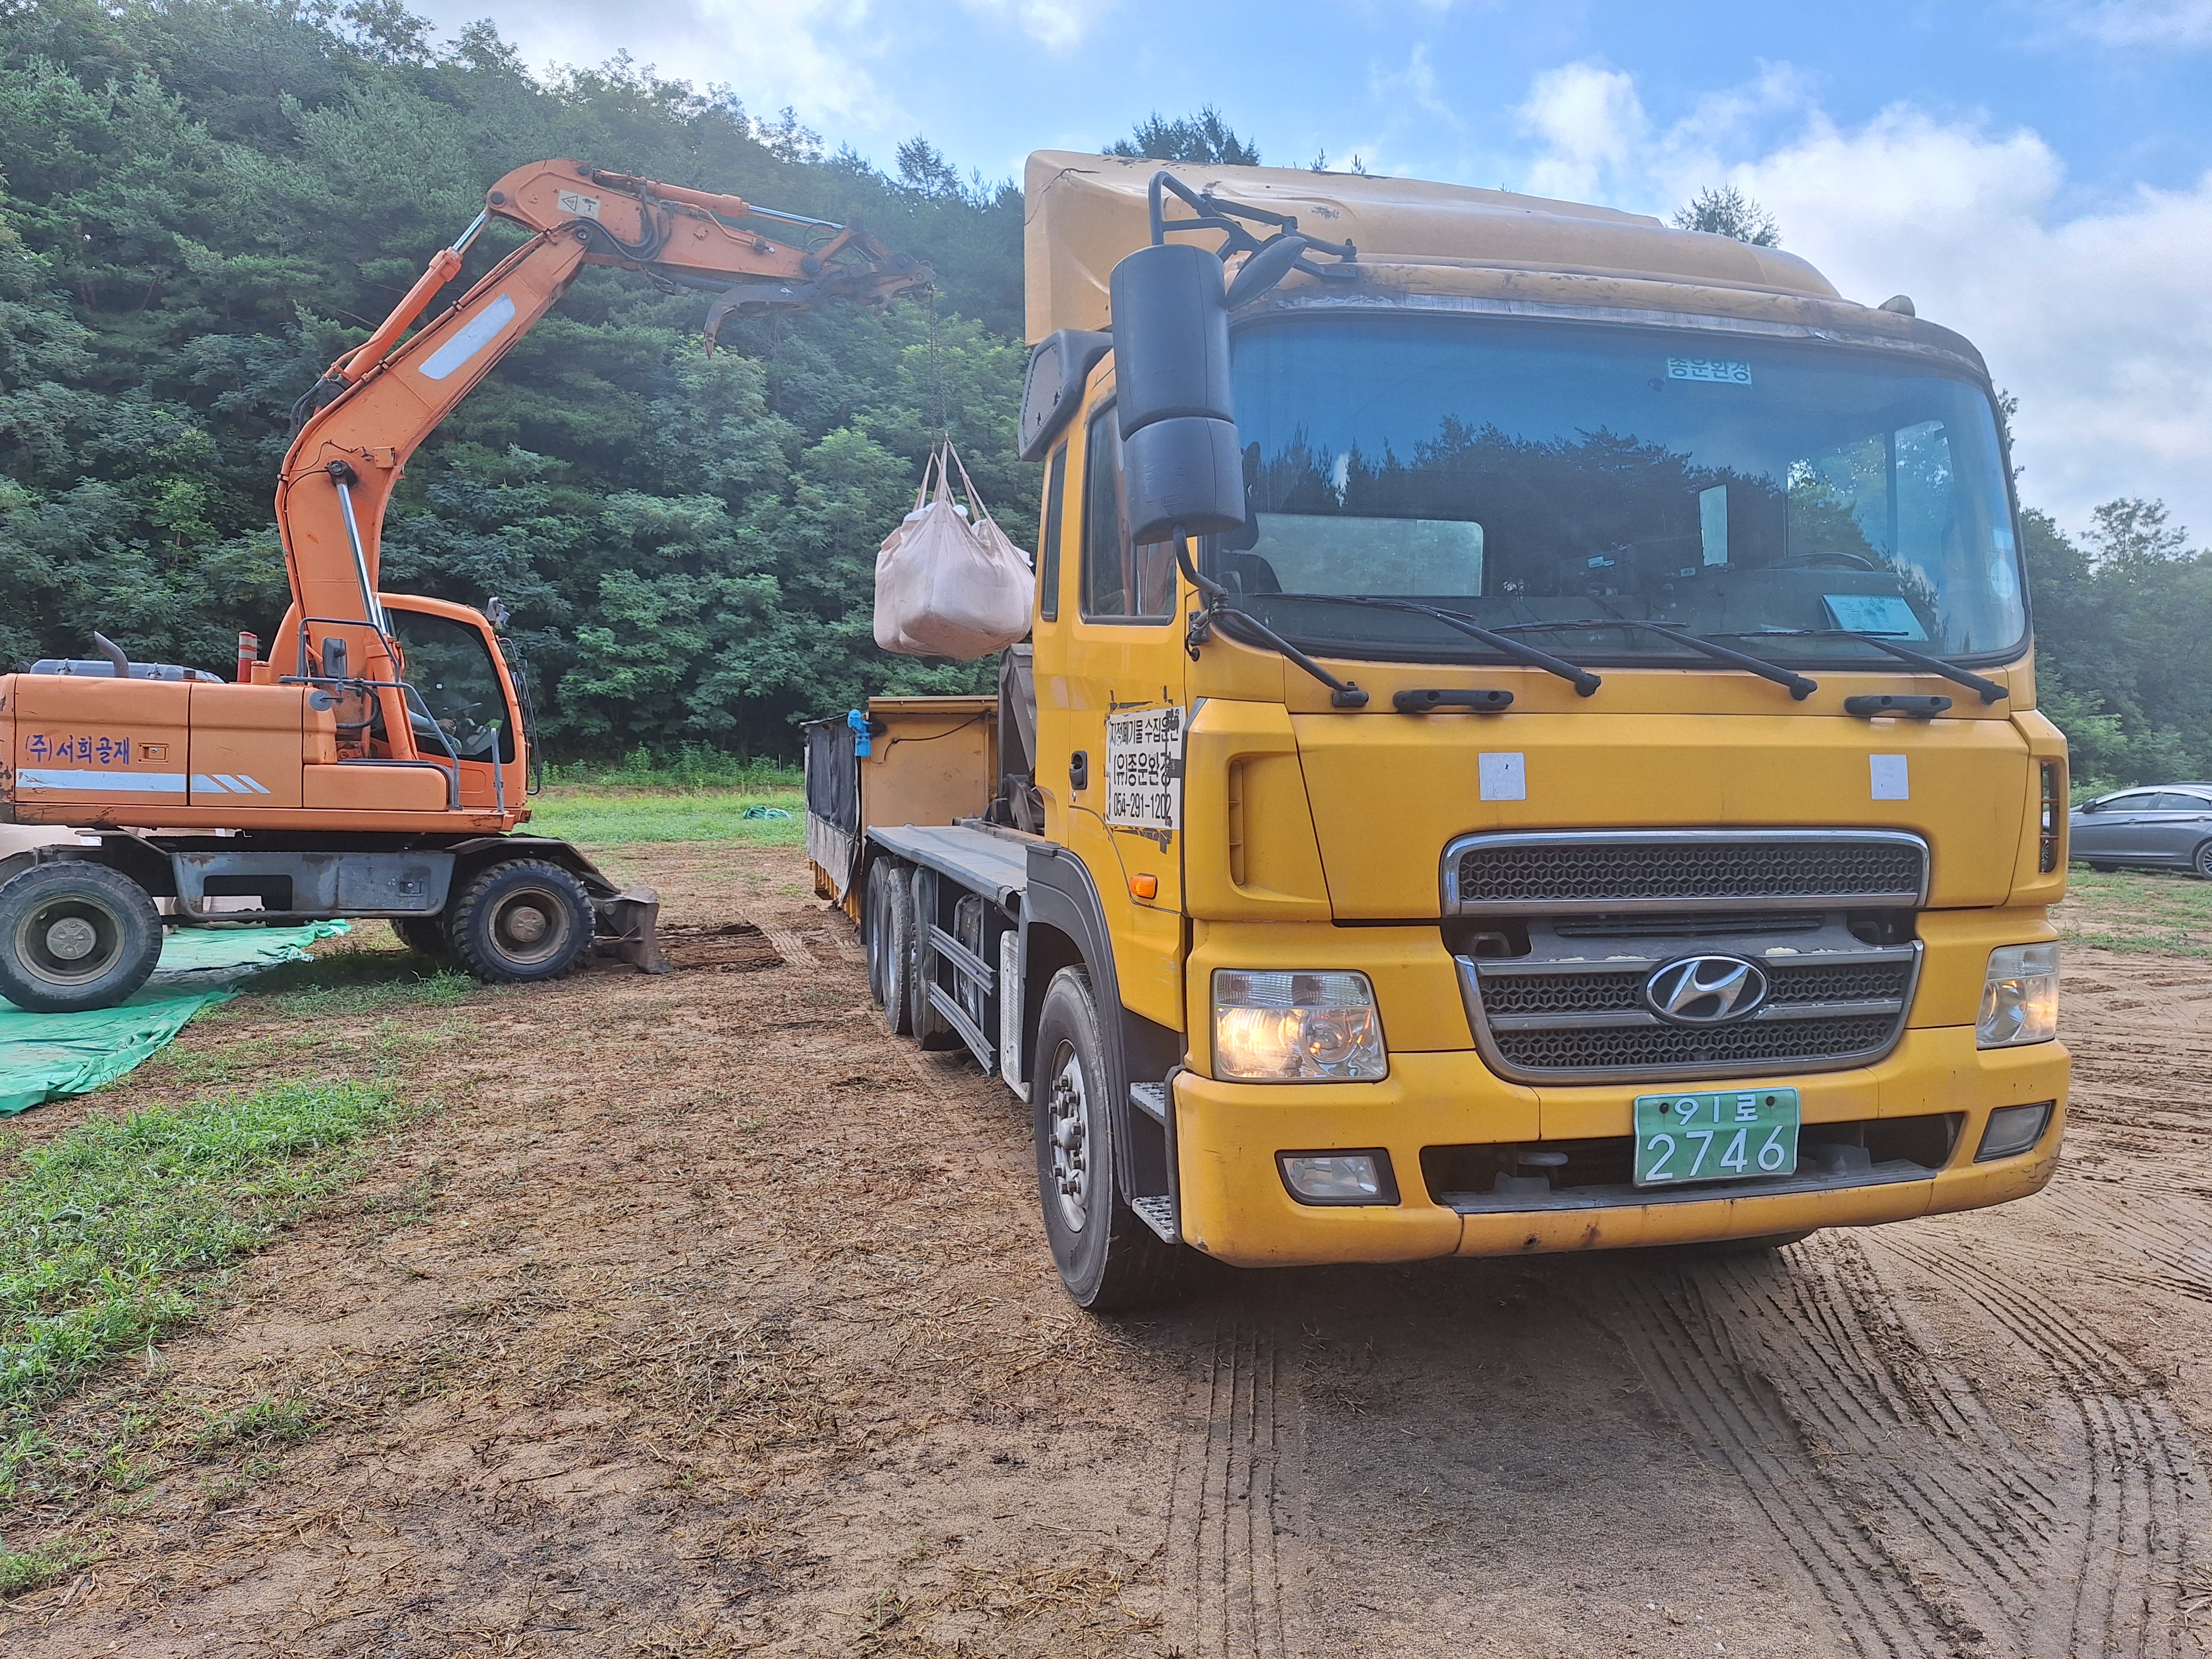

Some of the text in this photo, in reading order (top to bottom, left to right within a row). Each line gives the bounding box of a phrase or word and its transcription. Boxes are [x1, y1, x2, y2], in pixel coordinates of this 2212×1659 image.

[1669, 357, 1750, 381] 종운환경
[1110, 719, 1143, 746] 지정폐기물
[1114, 792, 1172, 819] 054-291-1202
[1674, 1094, 1759, 1126] 91로
[1644, 1125, 1785, 1181] 2746
